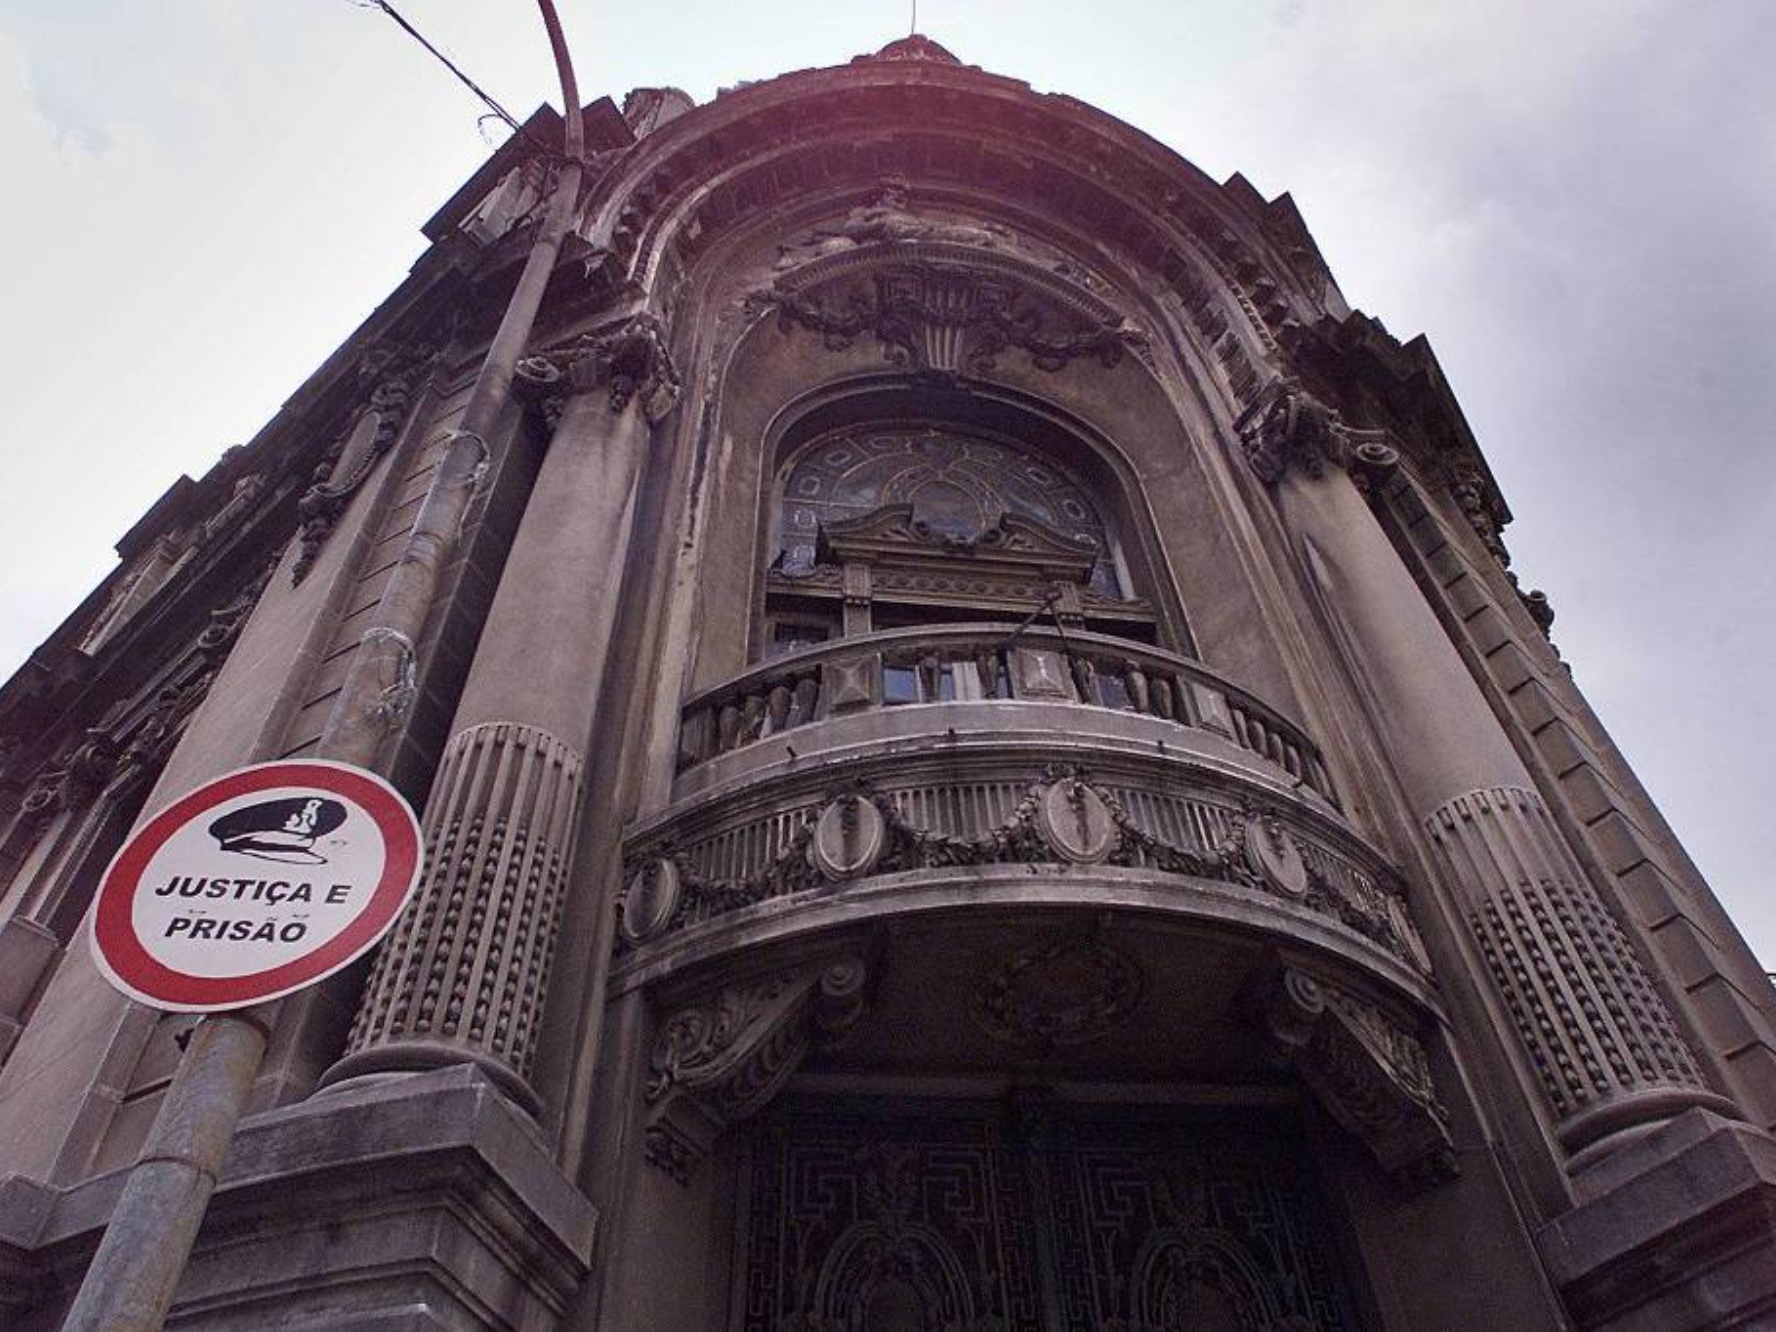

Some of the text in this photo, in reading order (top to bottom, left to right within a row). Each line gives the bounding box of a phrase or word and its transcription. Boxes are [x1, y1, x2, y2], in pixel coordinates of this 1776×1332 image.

[155, 876, 352, 906] JUSTIÇA E
[164, 917, 307, 943] PRISÃO
